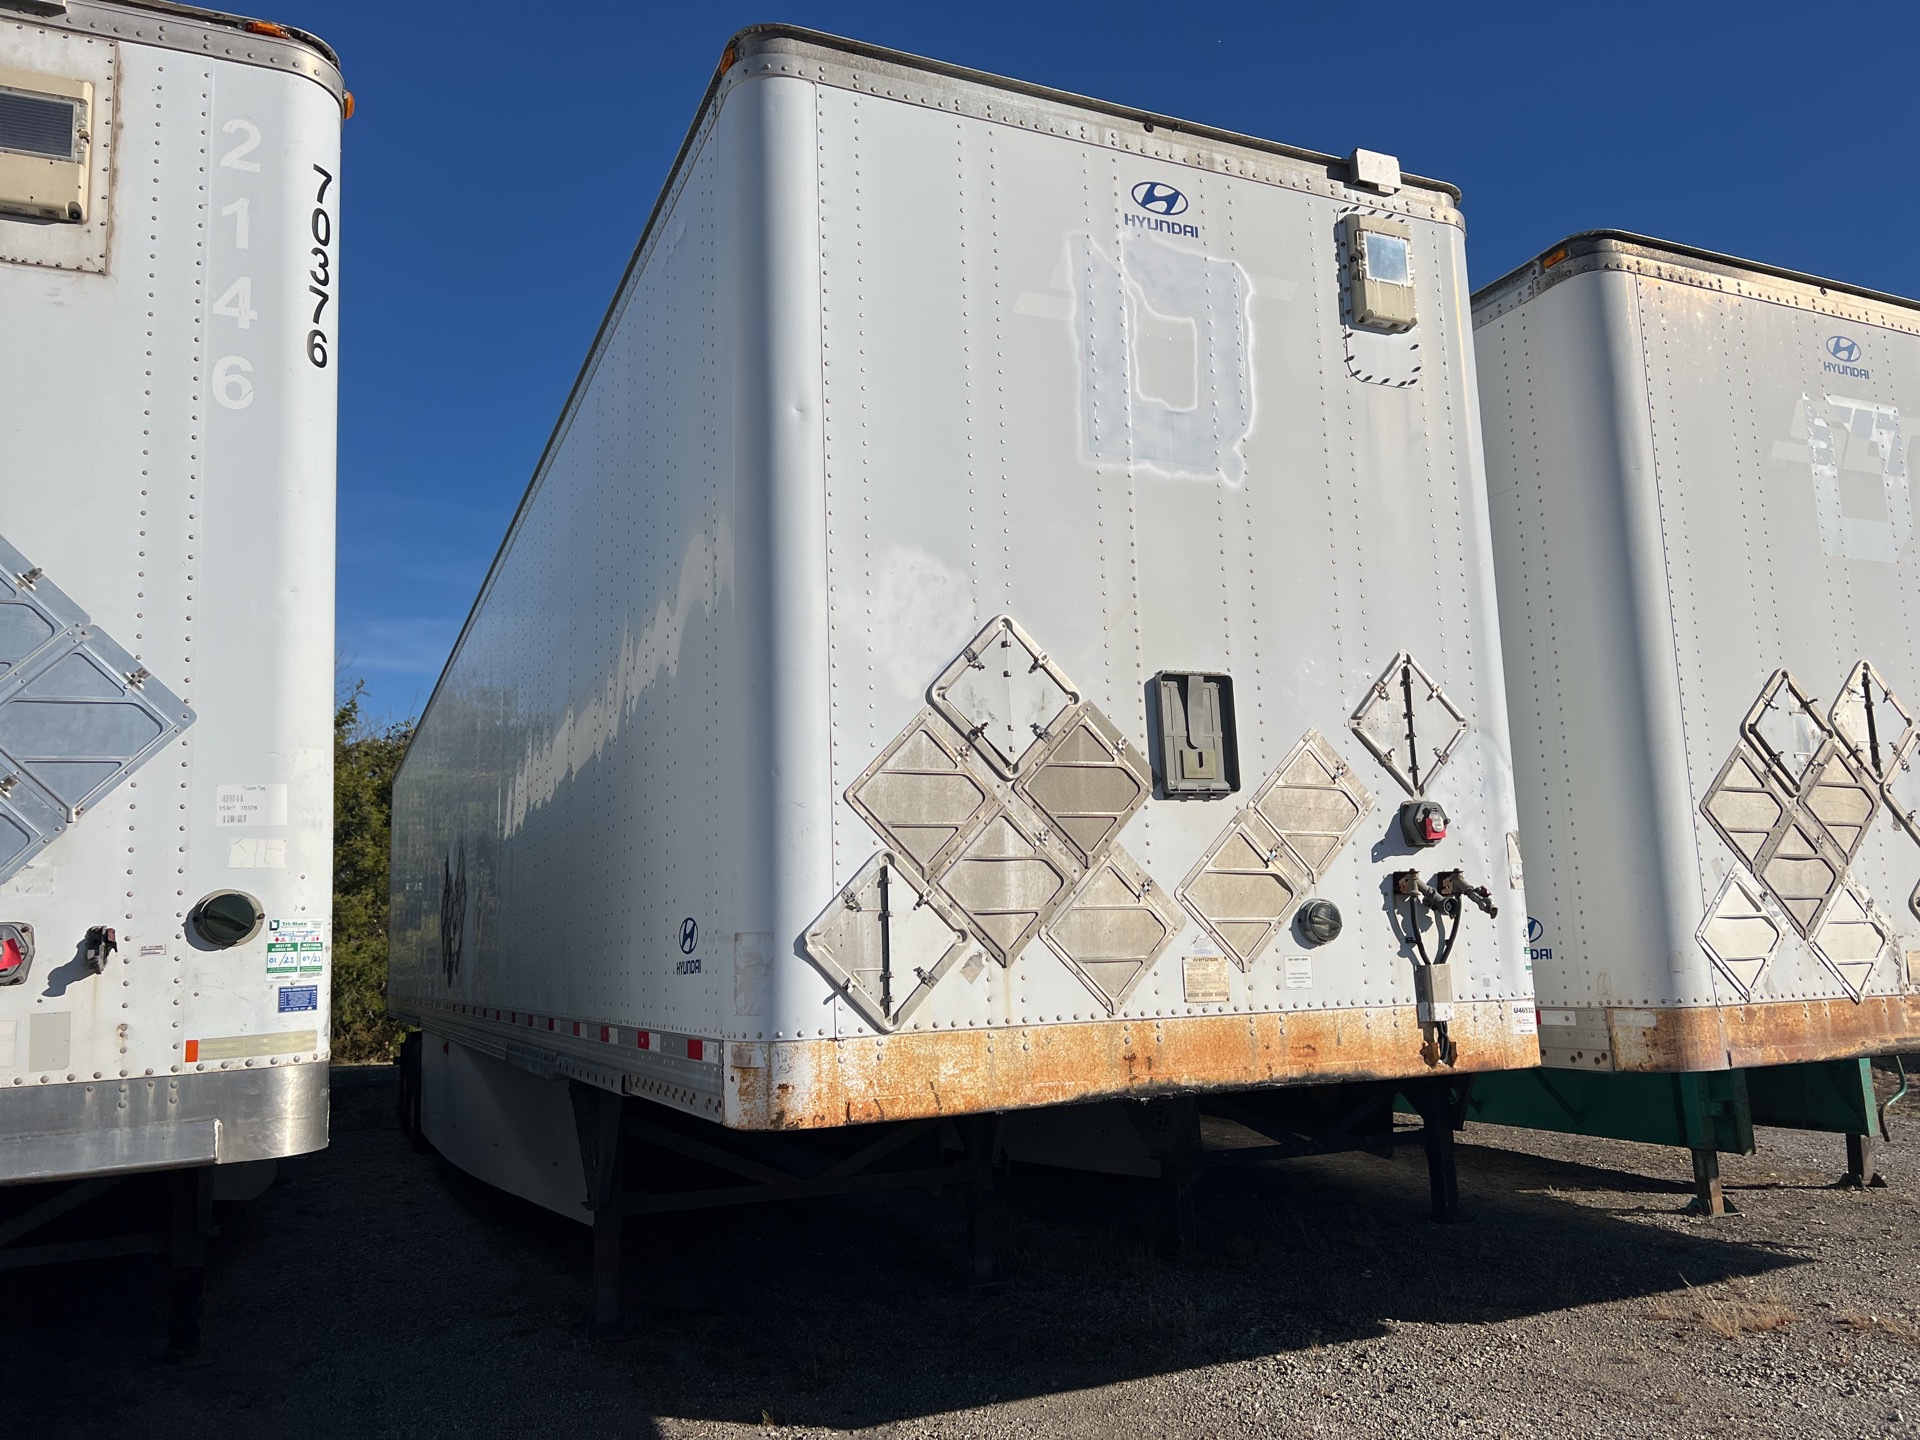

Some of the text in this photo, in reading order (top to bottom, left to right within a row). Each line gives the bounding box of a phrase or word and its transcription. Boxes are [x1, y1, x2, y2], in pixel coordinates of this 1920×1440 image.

[1124, 213, 1199, 238] HYUNDAI
[212, 118, 262, 411] 2146
[306, 163, 333, 369] 70376
[1824, 361, 1870, 379] HYUNDAI
[677, 959, 701, 975] HYUNDAI
